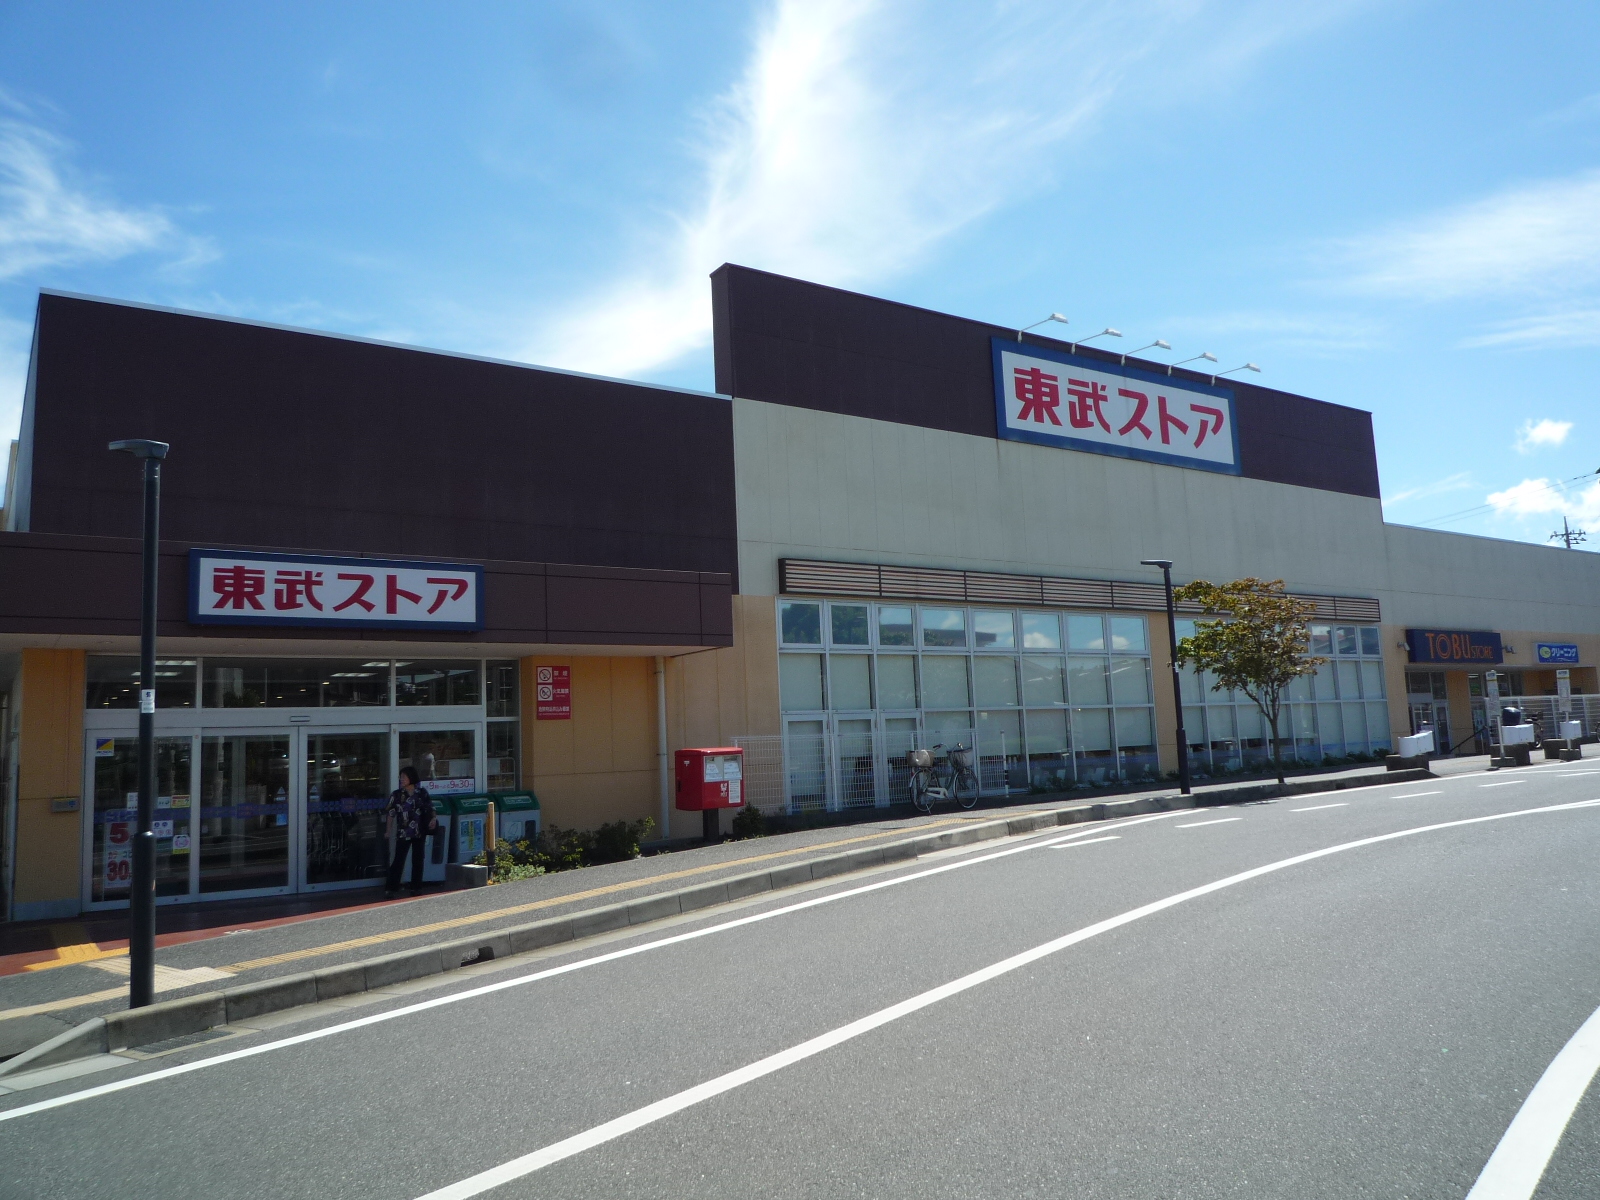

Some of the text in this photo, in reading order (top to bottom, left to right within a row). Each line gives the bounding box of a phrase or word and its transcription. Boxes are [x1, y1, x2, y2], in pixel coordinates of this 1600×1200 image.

[1013, 367, 1225, 449] 東武ストア
[212, 565, 469, 615] 東武ストア
[1425, 632, 1494, 660] TOBU STORE
[1551, 647, 1577, 657] クリーニング
